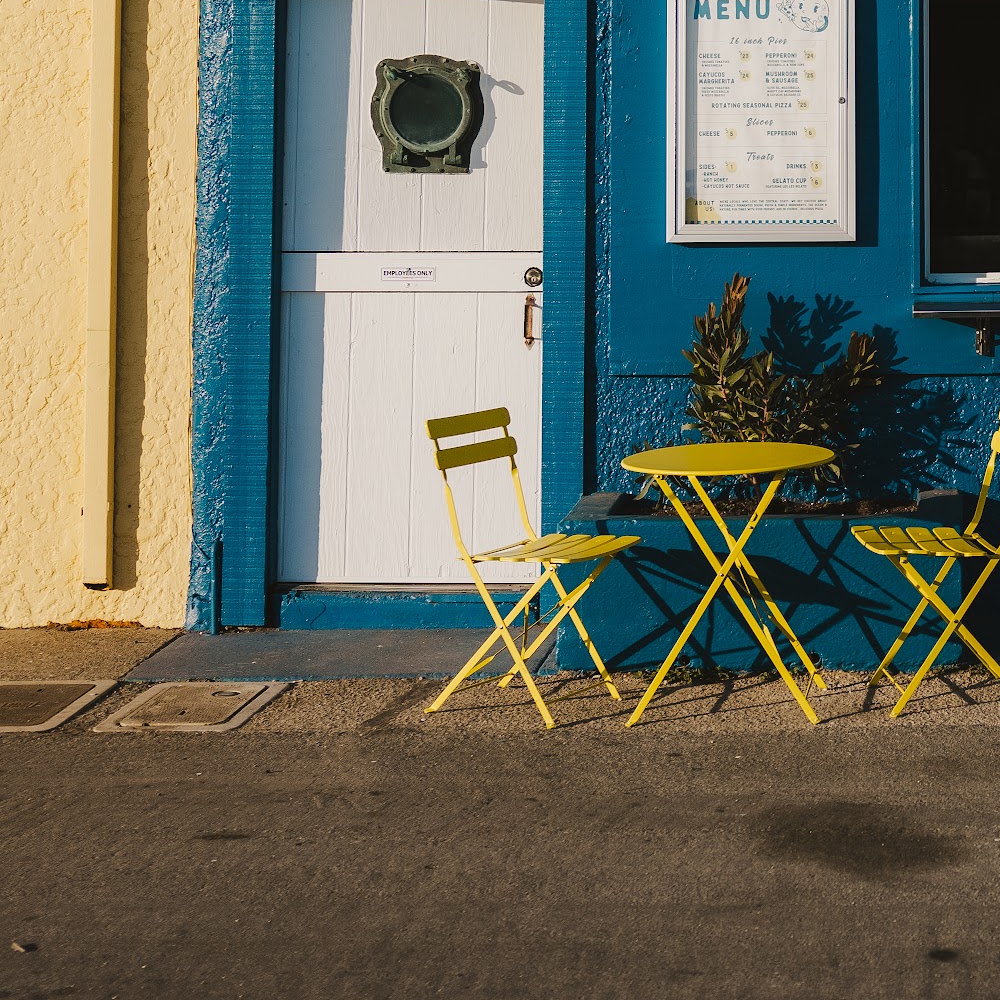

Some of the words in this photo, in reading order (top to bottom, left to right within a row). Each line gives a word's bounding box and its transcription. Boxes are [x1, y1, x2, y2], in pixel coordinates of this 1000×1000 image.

[693, 0, 770, 20] MENU
[767, 36, 788, 45] Pies
[746, 117, 774, 127] Slices
[746, 151, 775, 161] Treats
